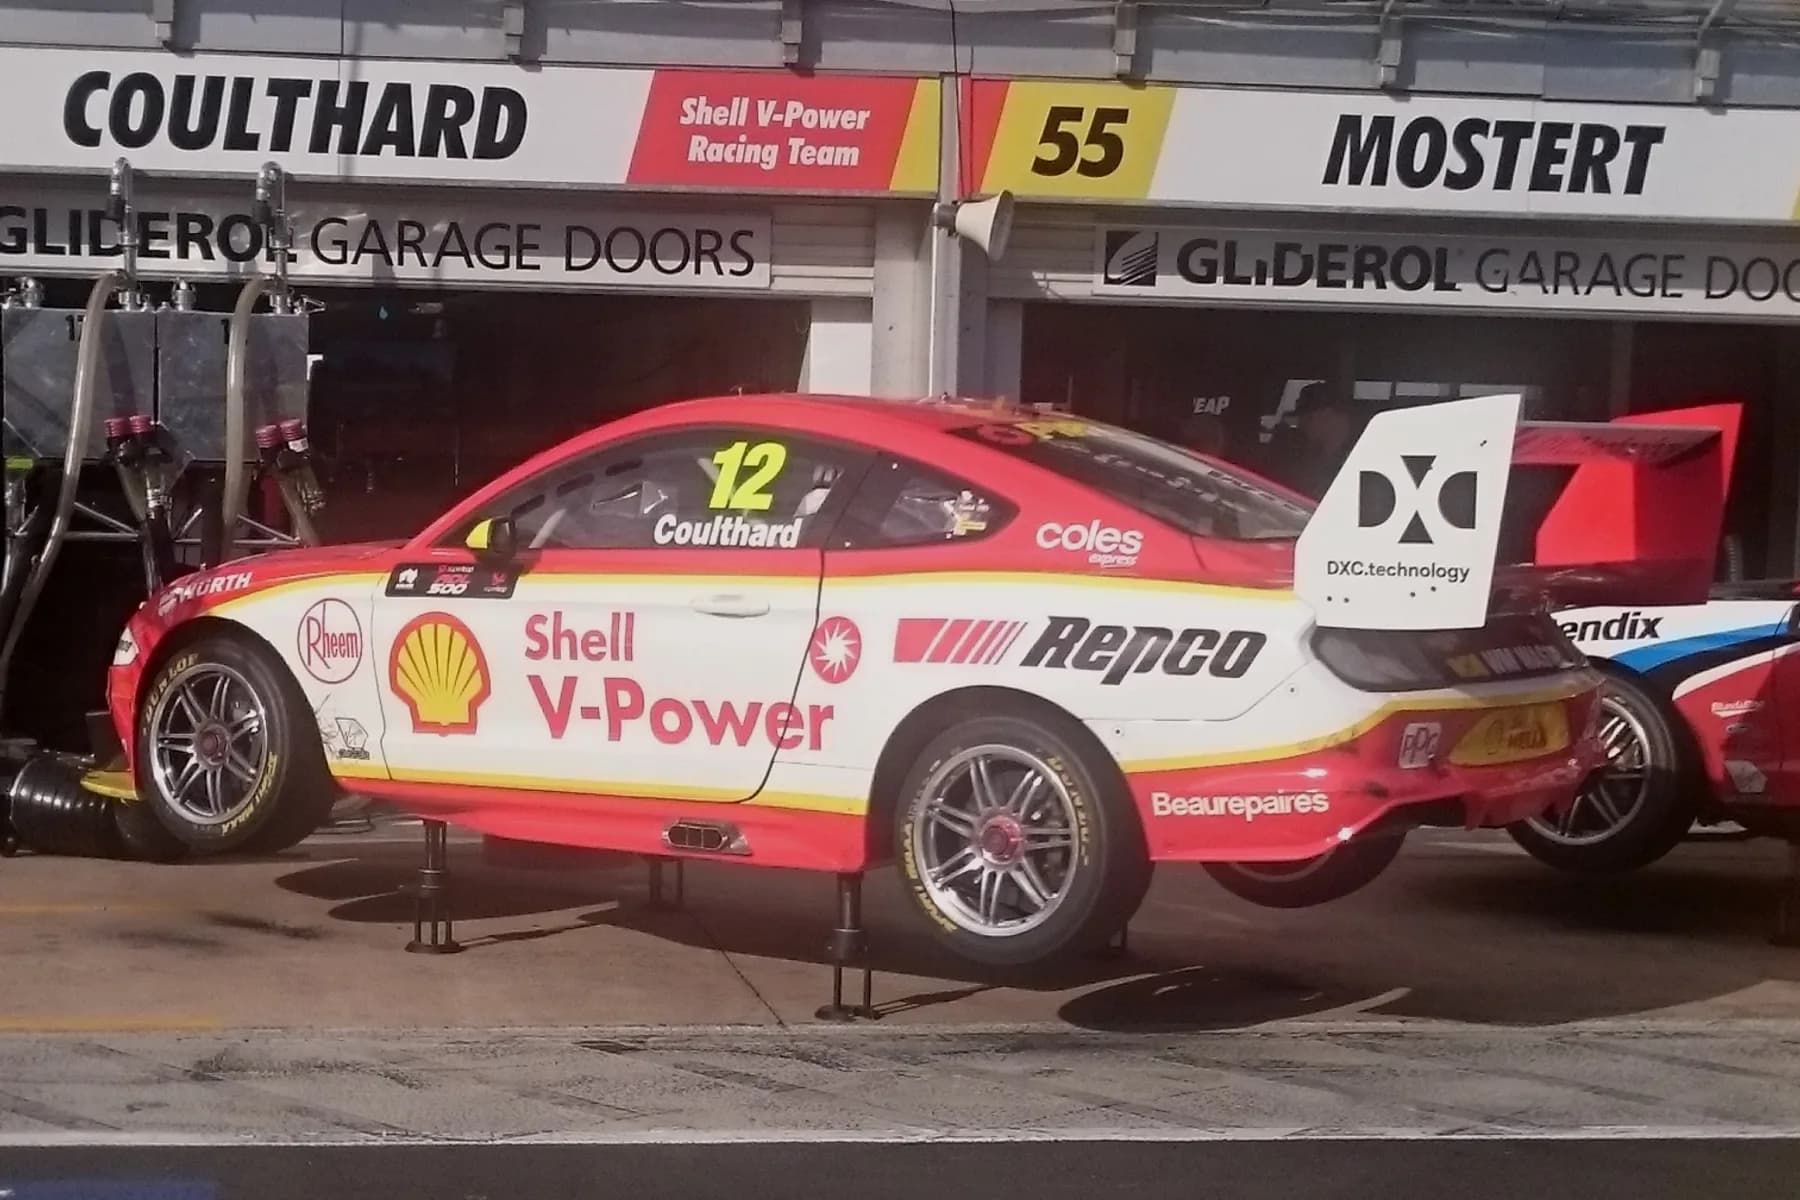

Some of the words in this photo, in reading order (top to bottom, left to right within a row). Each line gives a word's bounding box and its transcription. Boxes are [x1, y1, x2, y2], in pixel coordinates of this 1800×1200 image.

[63, 71, 528, 160] COULTHARD
[679, 96, 749, 126] Shell
[757, 100, 870, 130] V-Power
[688, 134, 779, 170] Racing
[788, 137, 859, 167] Team
[1031, 106, 1129, 178] 55
[1322, 114, 1666, 195] MOSTERT
[310, 217, 541, 271] GARAGE
[564, 225, 755, 276] DOORS
[1176, 238, 1462, 292] GLIDEROL
[1475, 248, 1685, 298] GARAGE
[1192, 396, 1231, 416] EAP
[709, 442, 786, 510] 12
[654, 513, 803, 549] Coulthard
[1036, 519, 1144, 555] coles
[1327, 560, 1470, 583] DXC.technology
[307, 602, 359, 669] Rheem
[525, 611, 635, 662] Shell
[1019, 615, 1267, 686] Repco
[1560, 611, 1664, 642] endix
[526, 674, 834, 750] V-Power
[1151, 789, 1330, 822] Beaurepaires
